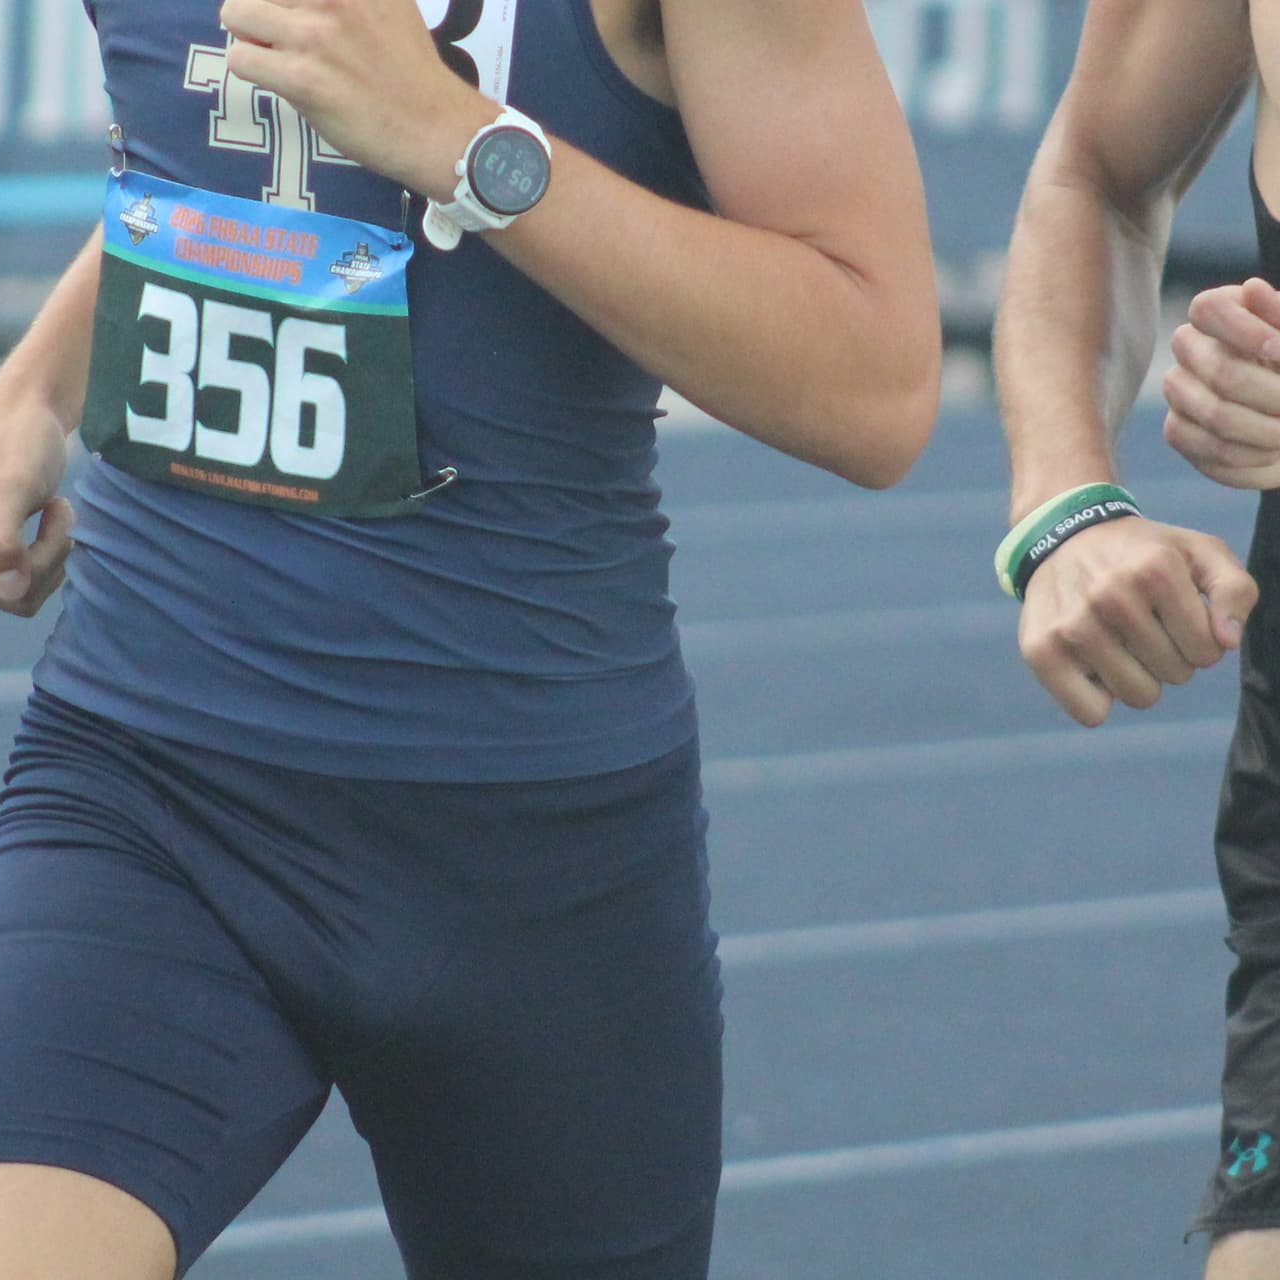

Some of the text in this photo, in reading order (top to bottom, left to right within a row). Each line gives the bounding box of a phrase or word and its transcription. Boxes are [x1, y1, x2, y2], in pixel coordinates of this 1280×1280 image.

[264, 227, 320, 259] STATE
[175, 237, 304, 286] CHAMPIONSHIPS
[126, 282, 348, 481] 356
[1055, 504, 1107, 535] Loves
[1029, 533, 1058, 560] You
